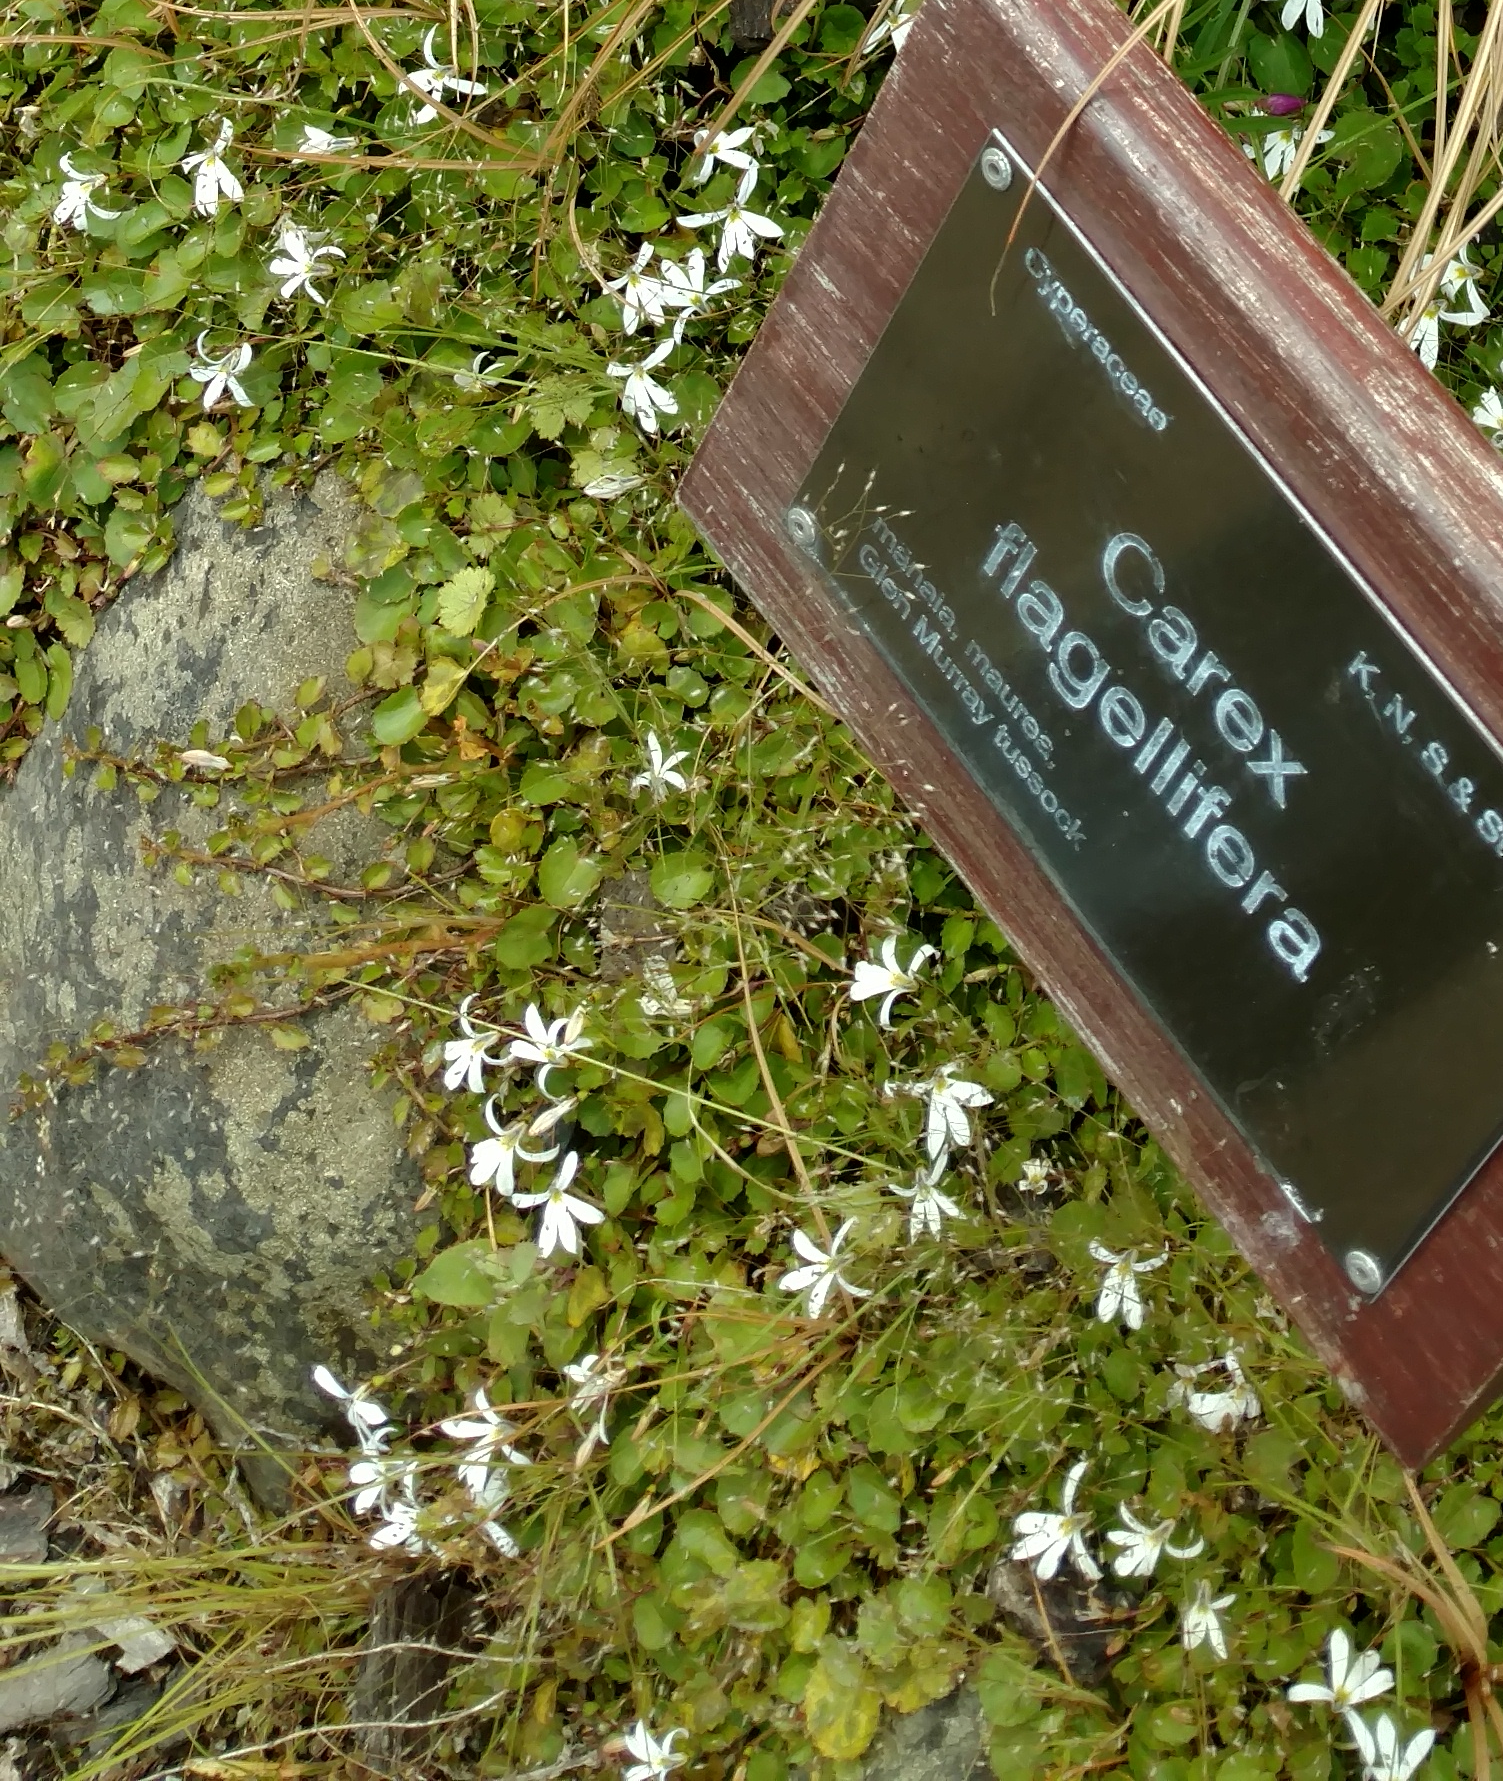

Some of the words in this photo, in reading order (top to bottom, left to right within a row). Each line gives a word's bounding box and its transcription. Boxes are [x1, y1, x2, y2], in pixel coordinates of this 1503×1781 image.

[1024, 246, 1168, 432] Cyperaceae
[859, 544, 912, 621] Glen
[912, 614, 996, 726] Murray
[993, 724, 1088, 852] tussock
[979, 520, 1321, 983] flagellifera
[1103, 532, 1309, 809] Carex
[1383, 692, 1418, 745] N,
[1419, 741, 1449, 776] S
[1448, 776, 1474, 814] &
